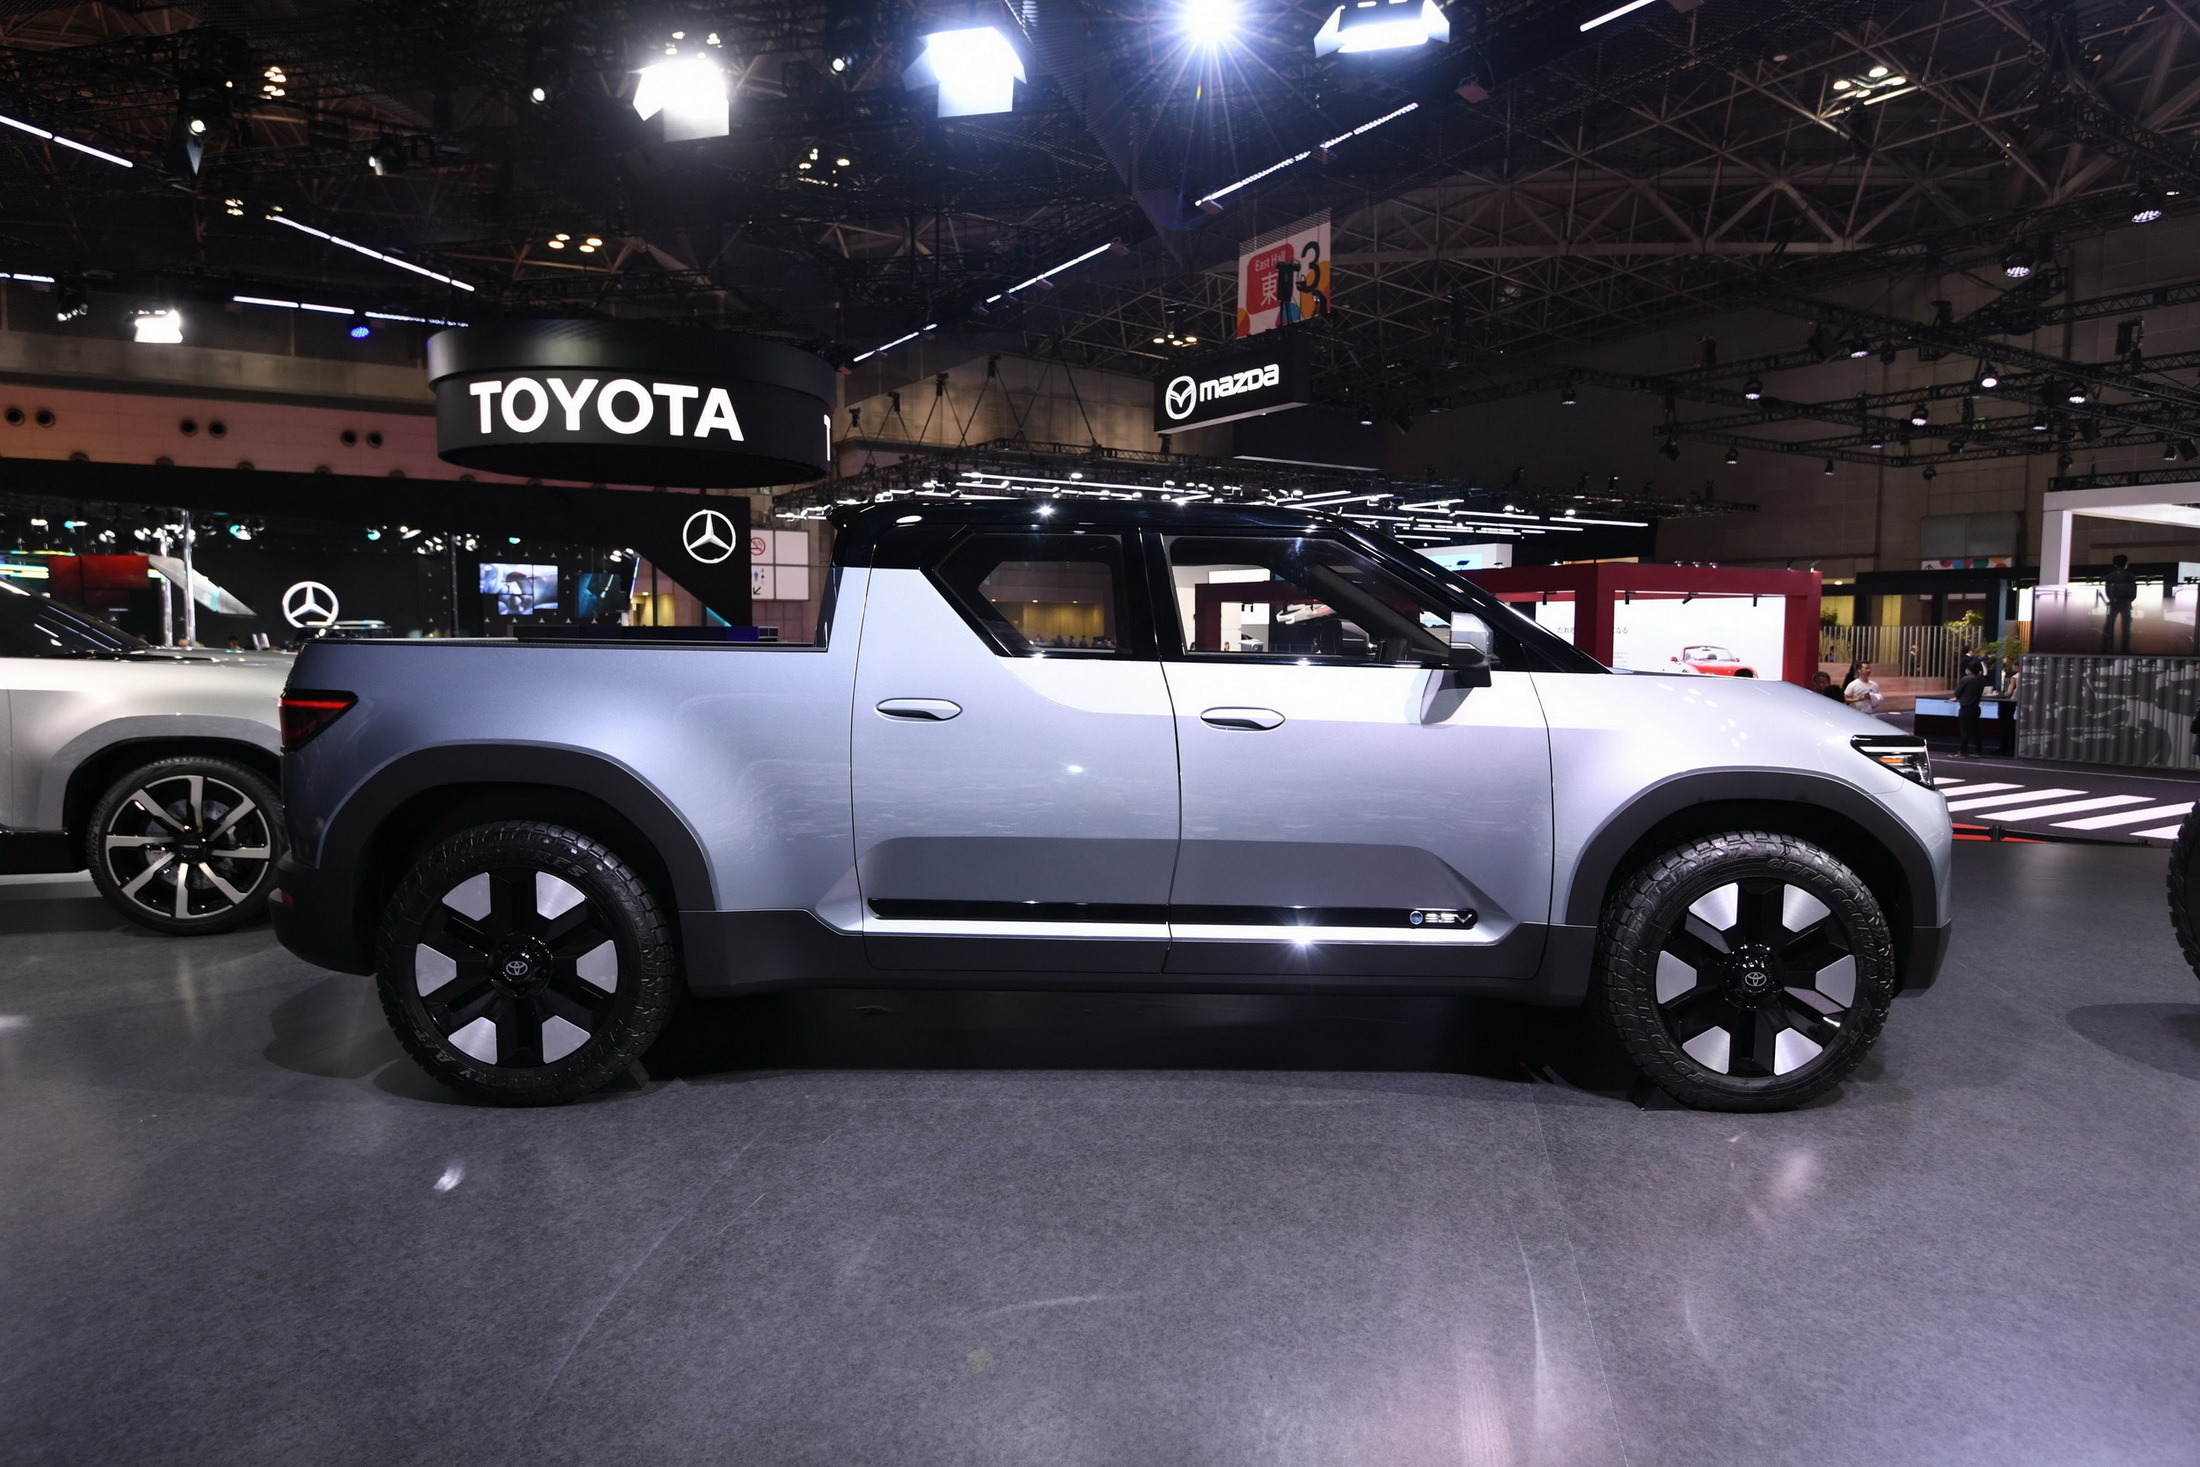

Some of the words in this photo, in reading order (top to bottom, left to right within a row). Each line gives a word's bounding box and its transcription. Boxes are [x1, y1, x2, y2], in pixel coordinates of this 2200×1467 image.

[1254, 257, 1271, 272] East
[1296, 241, 1320, 293] 3
[1260, 271, 1280, 306] 東
[469, 377, 744, 442] TOYOTA
